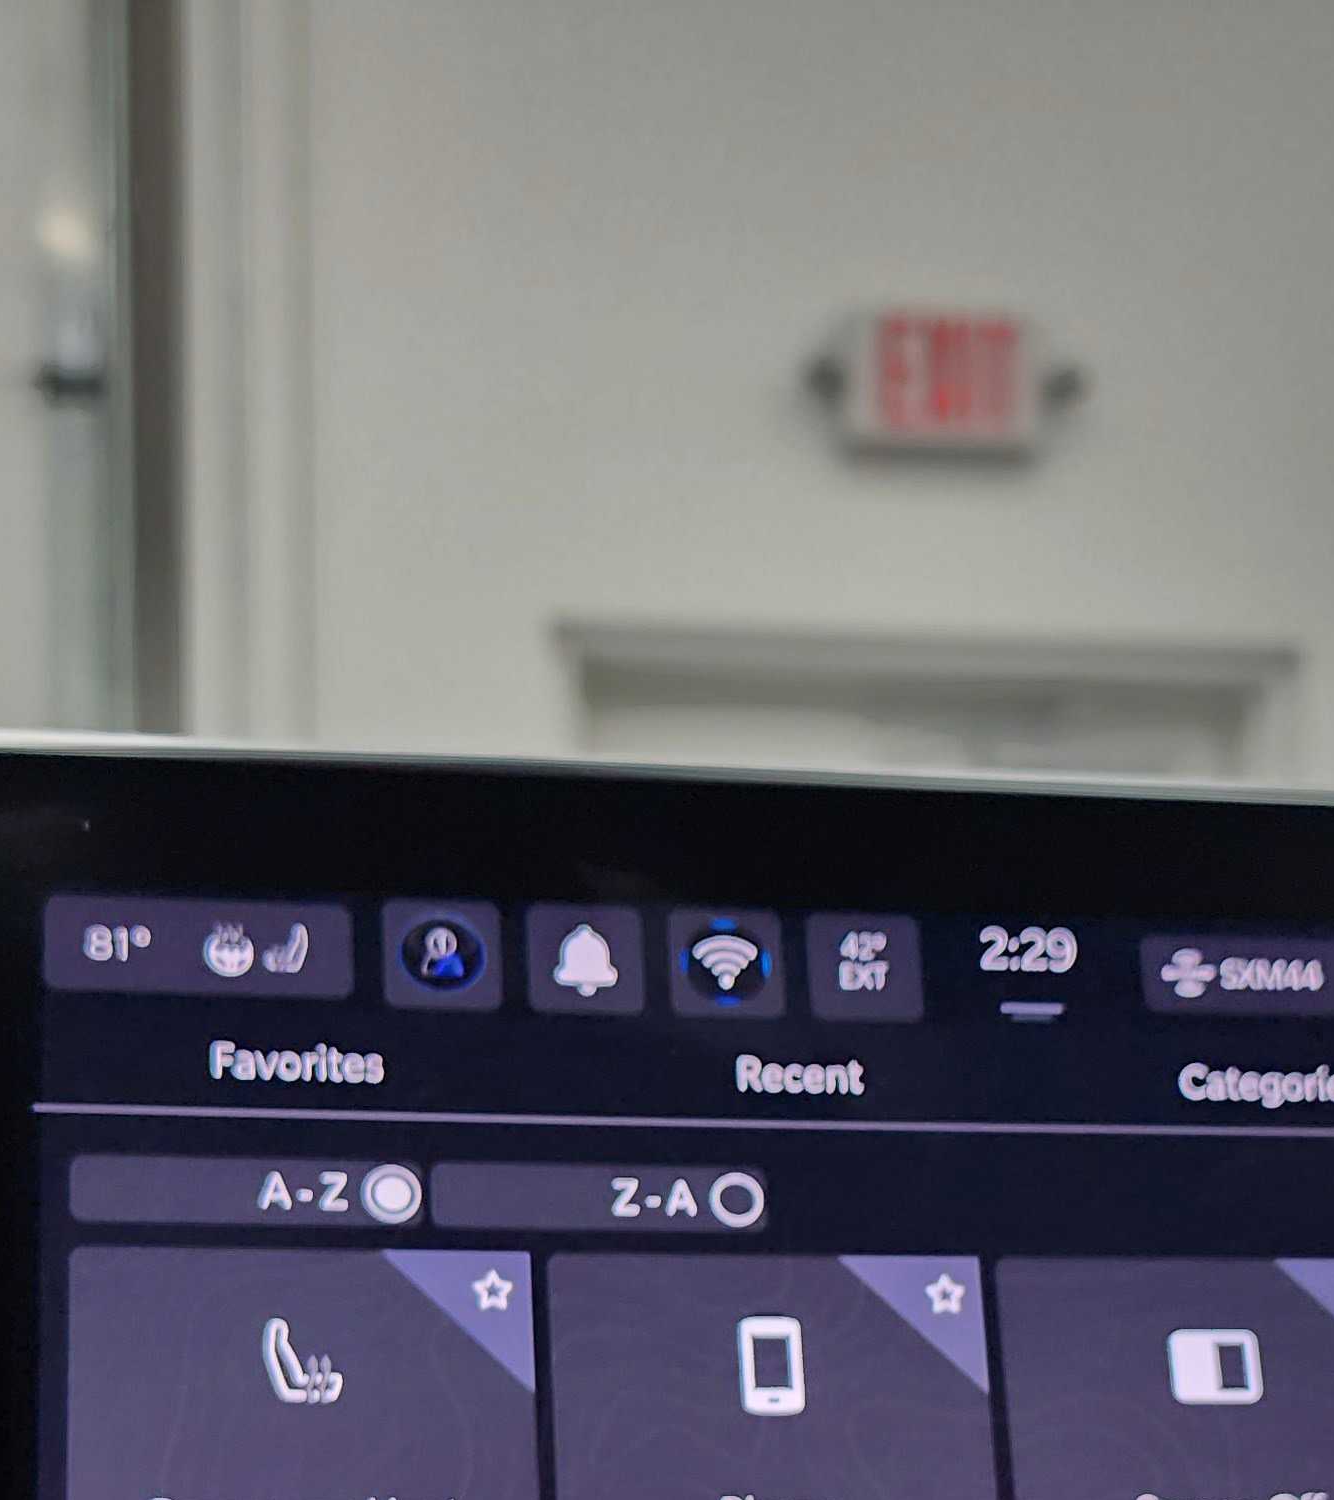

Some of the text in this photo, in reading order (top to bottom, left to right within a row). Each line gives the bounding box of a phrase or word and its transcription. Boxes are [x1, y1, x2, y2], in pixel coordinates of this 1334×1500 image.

[83, 924, 152, 962] 81°
[979, 925, 1078, 974] 2:29
[839, 959, 889, 991] EXT
[1220, 957, 1325, 991] SXM44
[209, 1040, 385, 1085] Favorites
[735, 1054, 866, 1096] Recent
